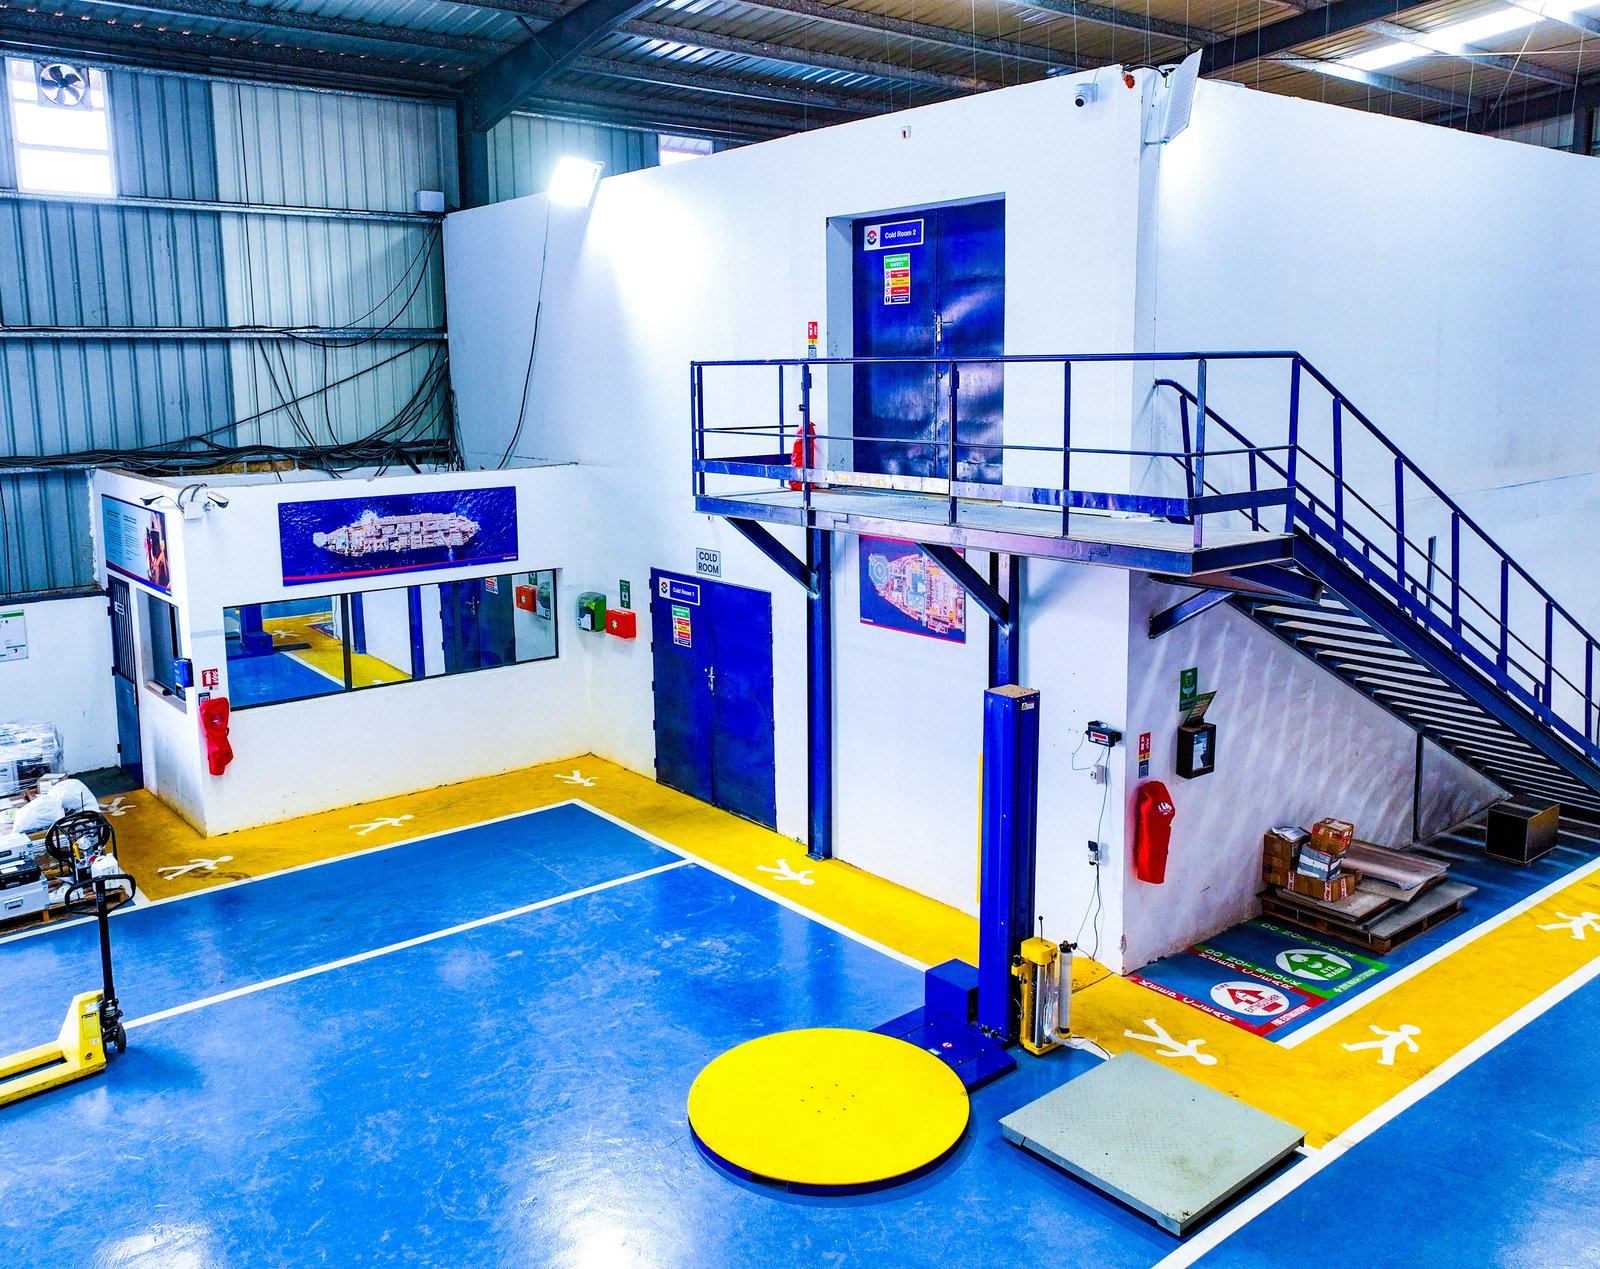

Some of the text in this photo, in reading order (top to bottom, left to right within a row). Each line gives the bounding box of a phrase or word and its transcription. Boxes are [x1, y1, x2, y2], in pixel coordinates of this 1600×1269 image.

[884, 231, 896, 239] Cold
[897, 229, 912, 238] Room
[699, 551, 718, 563] COLD
[698, 562, 719, 574] ROOM
[1261, 923, 1279, 931] DO
[1282, 930, 1307, 940] NOT
[1199, 952, 1294, 990] KEEP CLEAR
[1205, 948, 1302, 986] DO NOT BLOCK
[1319, 965, 1336, 974] EYE
[1324, 966, 1347, 978] WASH
[1138, 980, 1235, 1022] KEEP CLEAR
